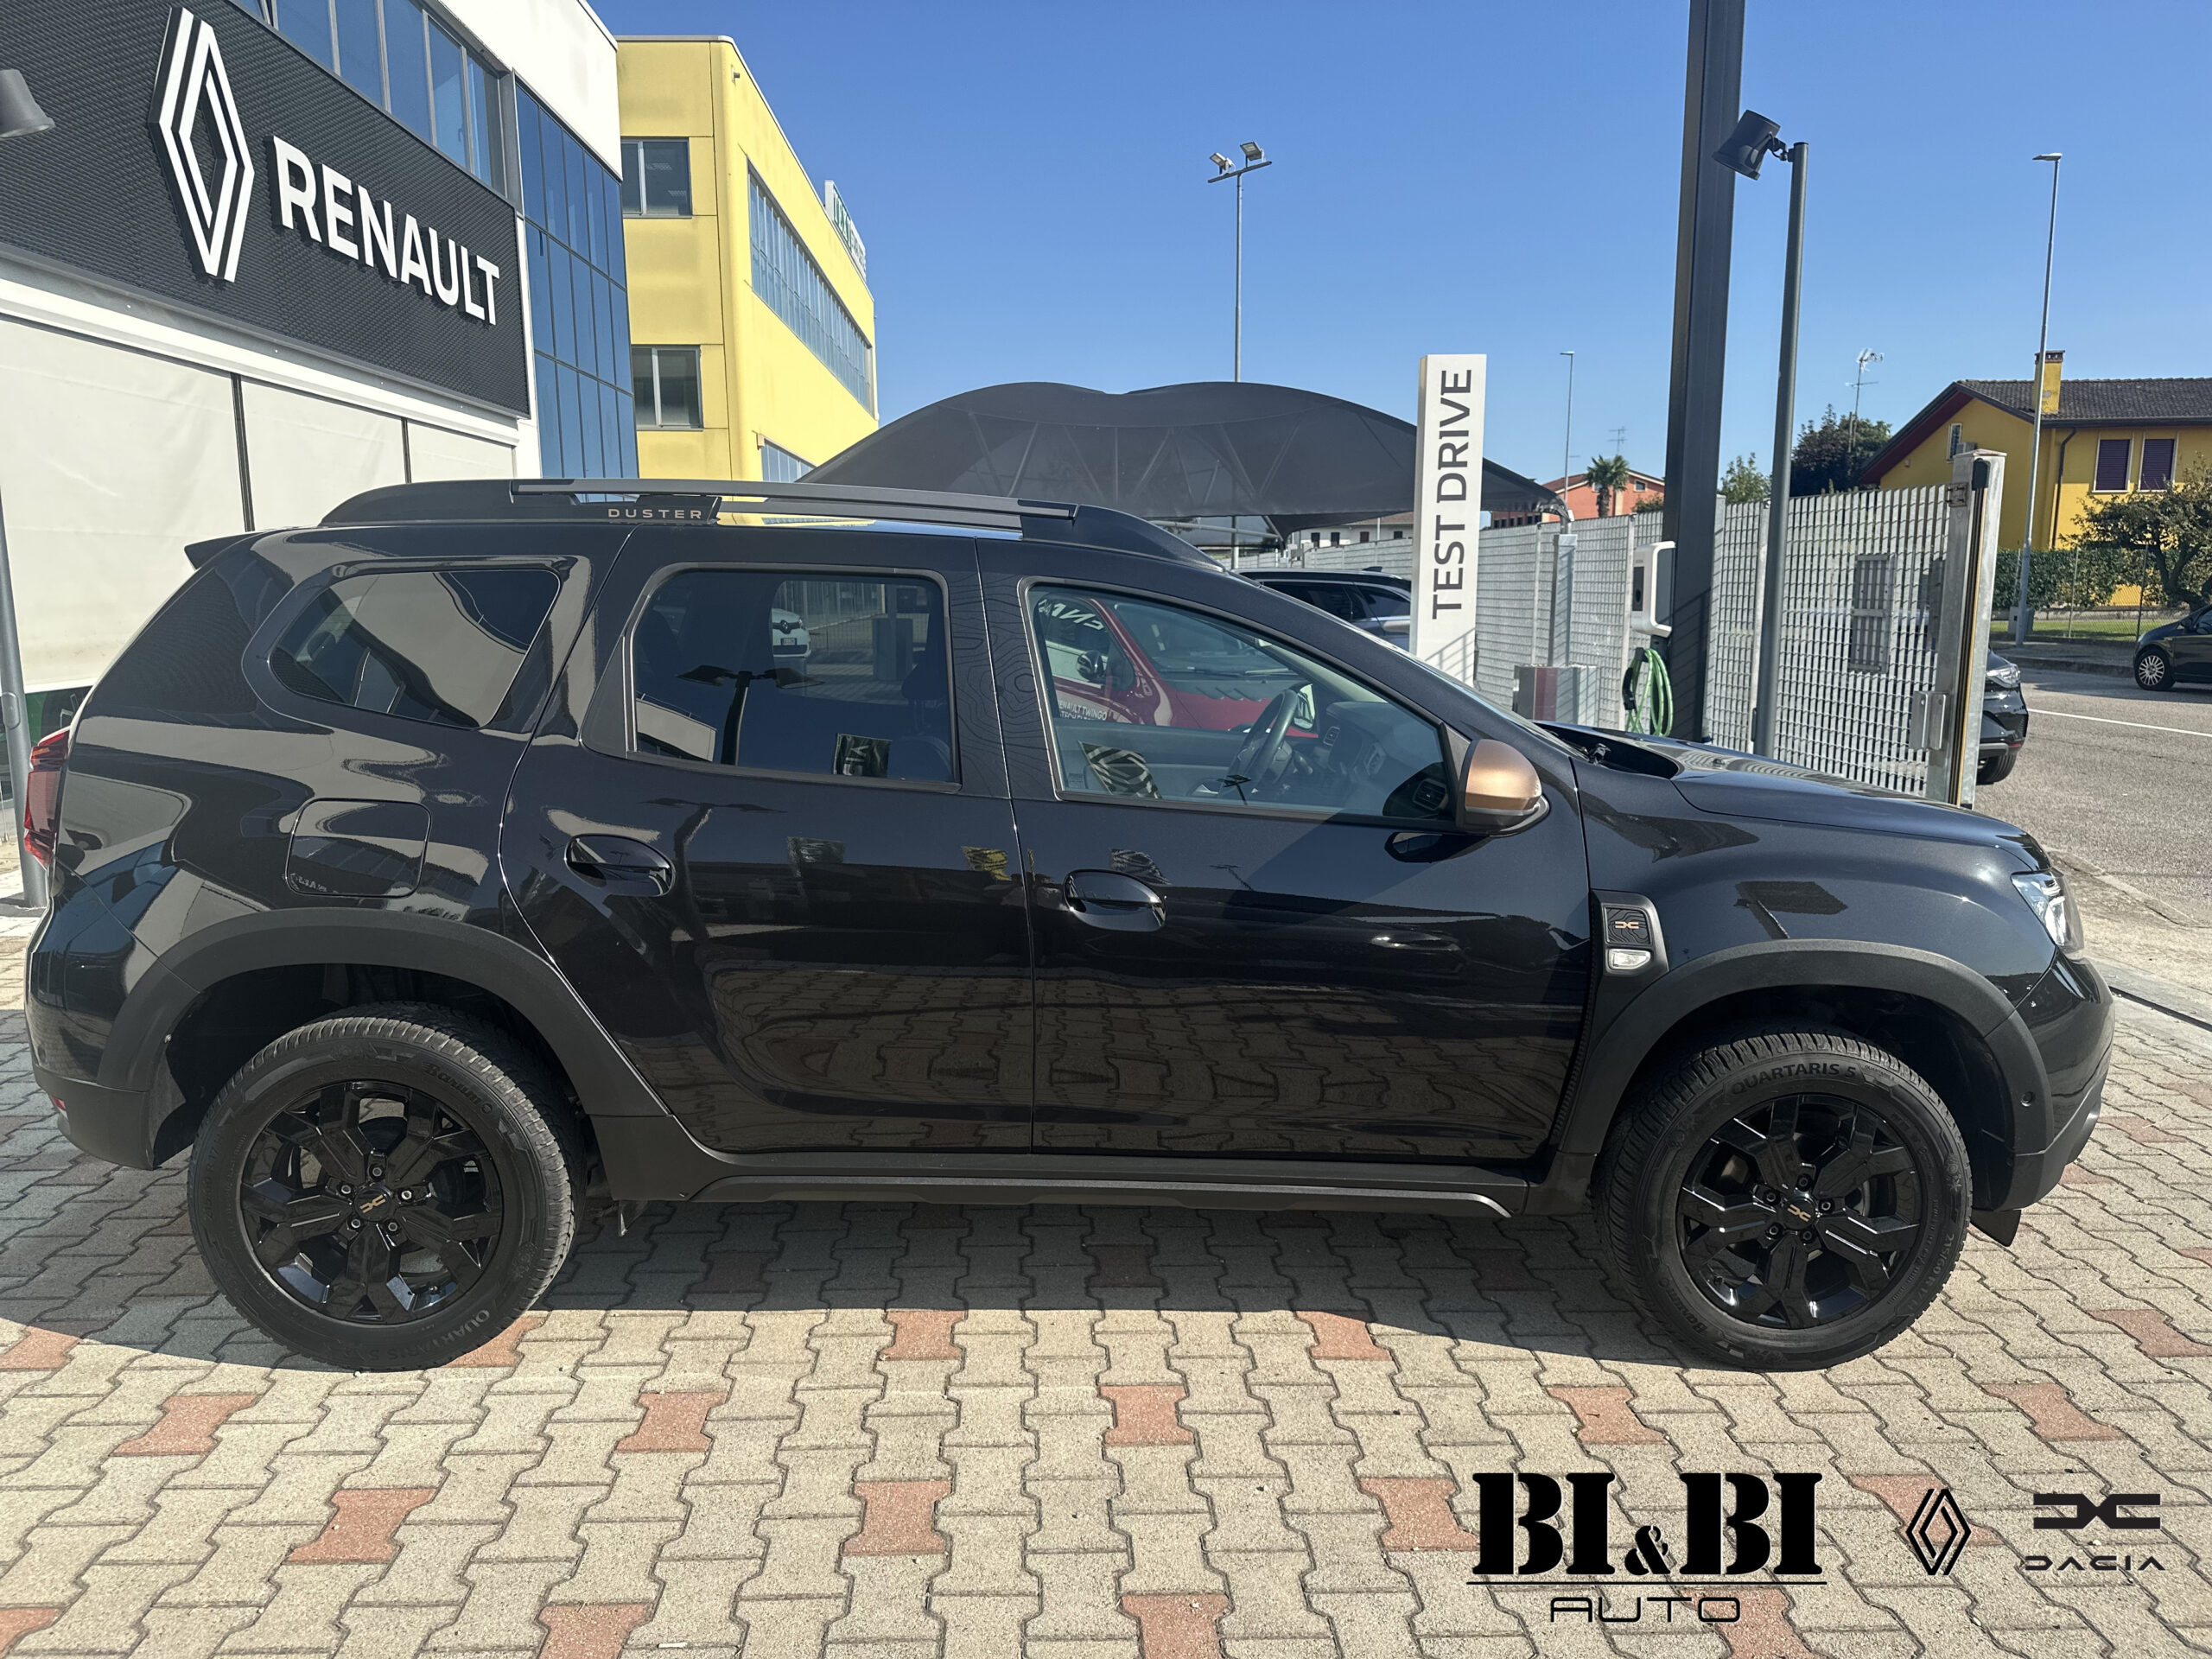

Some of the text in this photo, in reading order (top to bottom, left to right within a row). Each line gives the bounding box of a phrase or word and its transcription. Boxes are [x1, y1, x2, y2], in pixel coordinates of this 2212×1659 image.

[273, 135, 499, 325] RENAULT
[607, 508, 702, 519] DUSTER
[1433, 369, 1471, 620] TEST DRIVE
[1082, 706, 1108, 721] TWINGO
[422, 1062, 482, 1106] Barum
[1732, 1063, 1856, 1095] QUARTARIS 5
[1657, 1287, 1707, 1334] Barum
